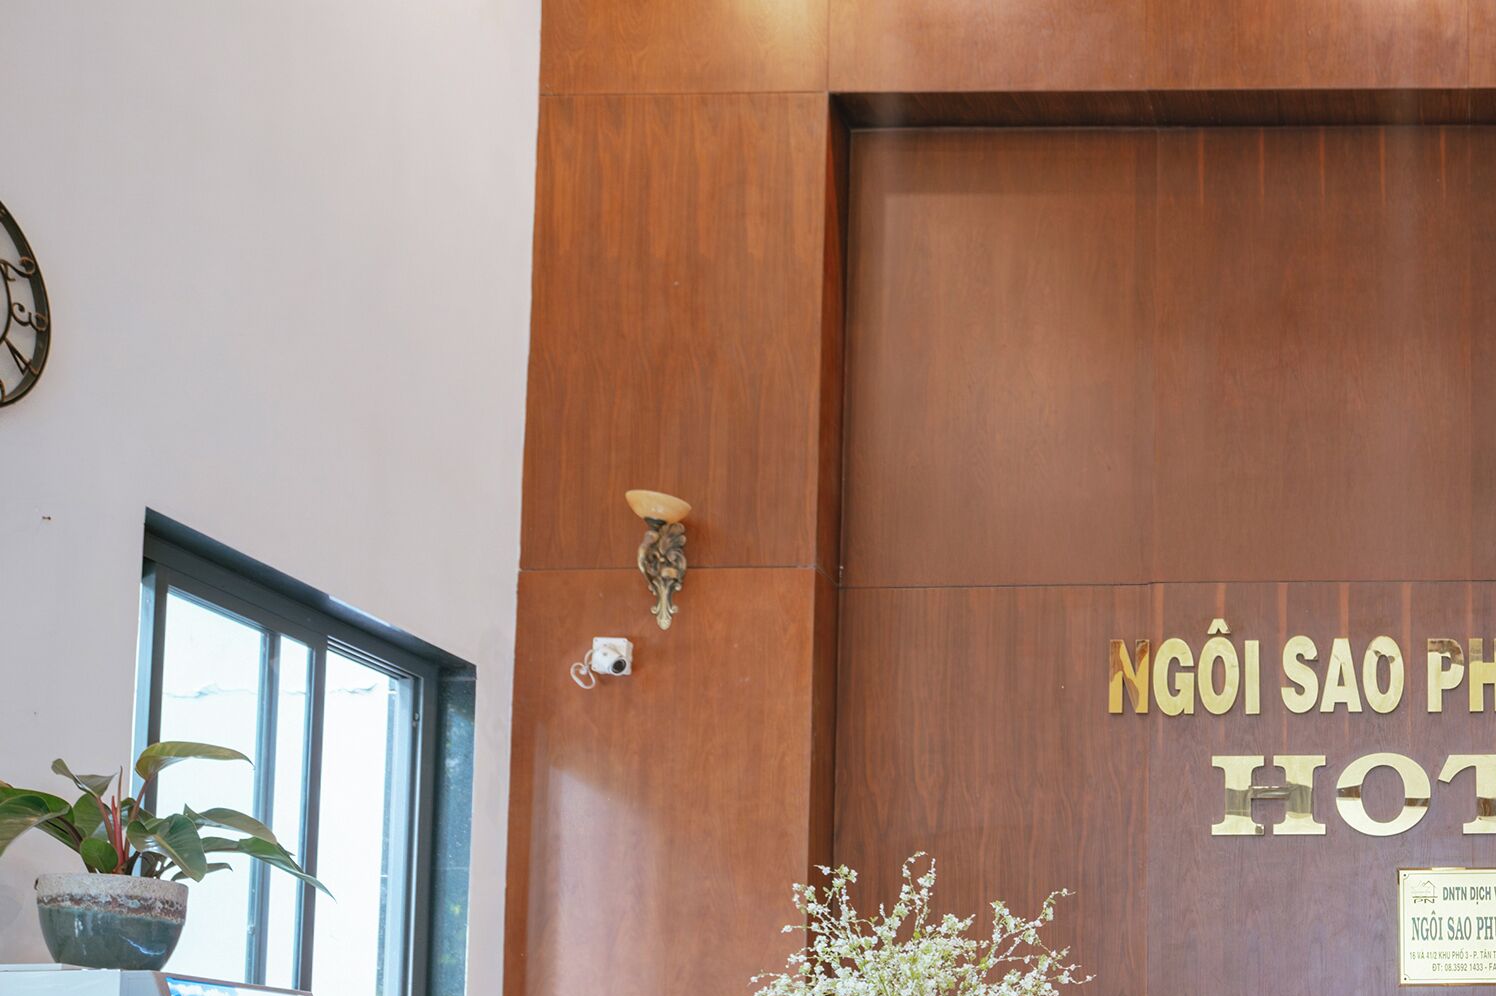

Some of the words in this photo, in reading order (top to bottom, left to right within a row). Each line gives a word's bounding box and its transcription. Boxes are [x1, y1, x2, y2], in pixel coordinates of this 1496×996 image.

[1109, 618, 1260, 716] NGÔI
[1281, 636, 1404, 714] SAO
[1443, 887, 1467, 900] DNTN
[1470, 886, 1491, 904] DỊCH
[1412, 910, 1443, 940] NGÔI
[1448, 917, 1471, 940] SAO
